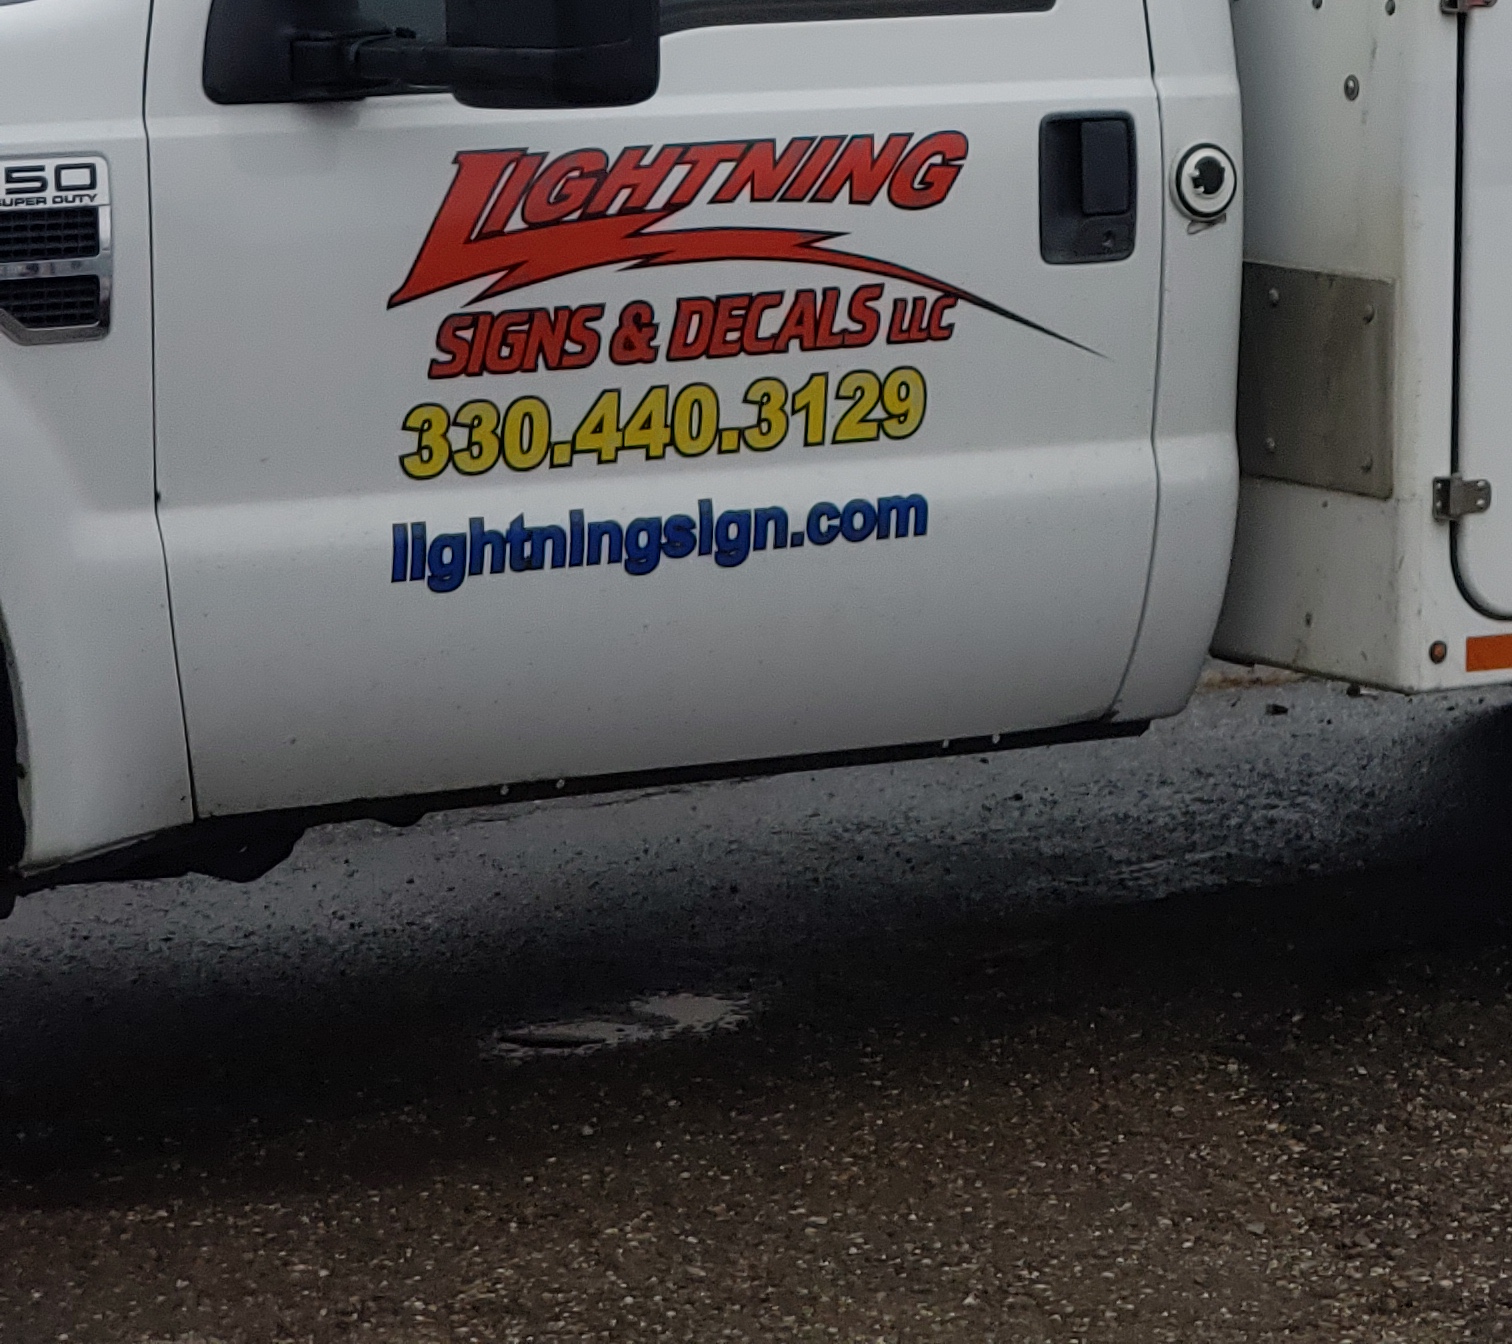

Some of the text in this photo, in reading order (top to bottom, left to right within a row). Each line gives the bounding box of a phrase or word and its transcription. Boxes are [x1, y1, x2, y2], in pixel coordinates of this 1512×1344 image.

[0, 194, 98, 207] UPER DUTY
[388, 130, 969, 308] LIGHTNING
[428, 283, 959, 379] SIGNS & DECALS LLC
[399, 366, 927, 480] 330.440.3129
[391, 490, 928, 593] lightningsign.com
